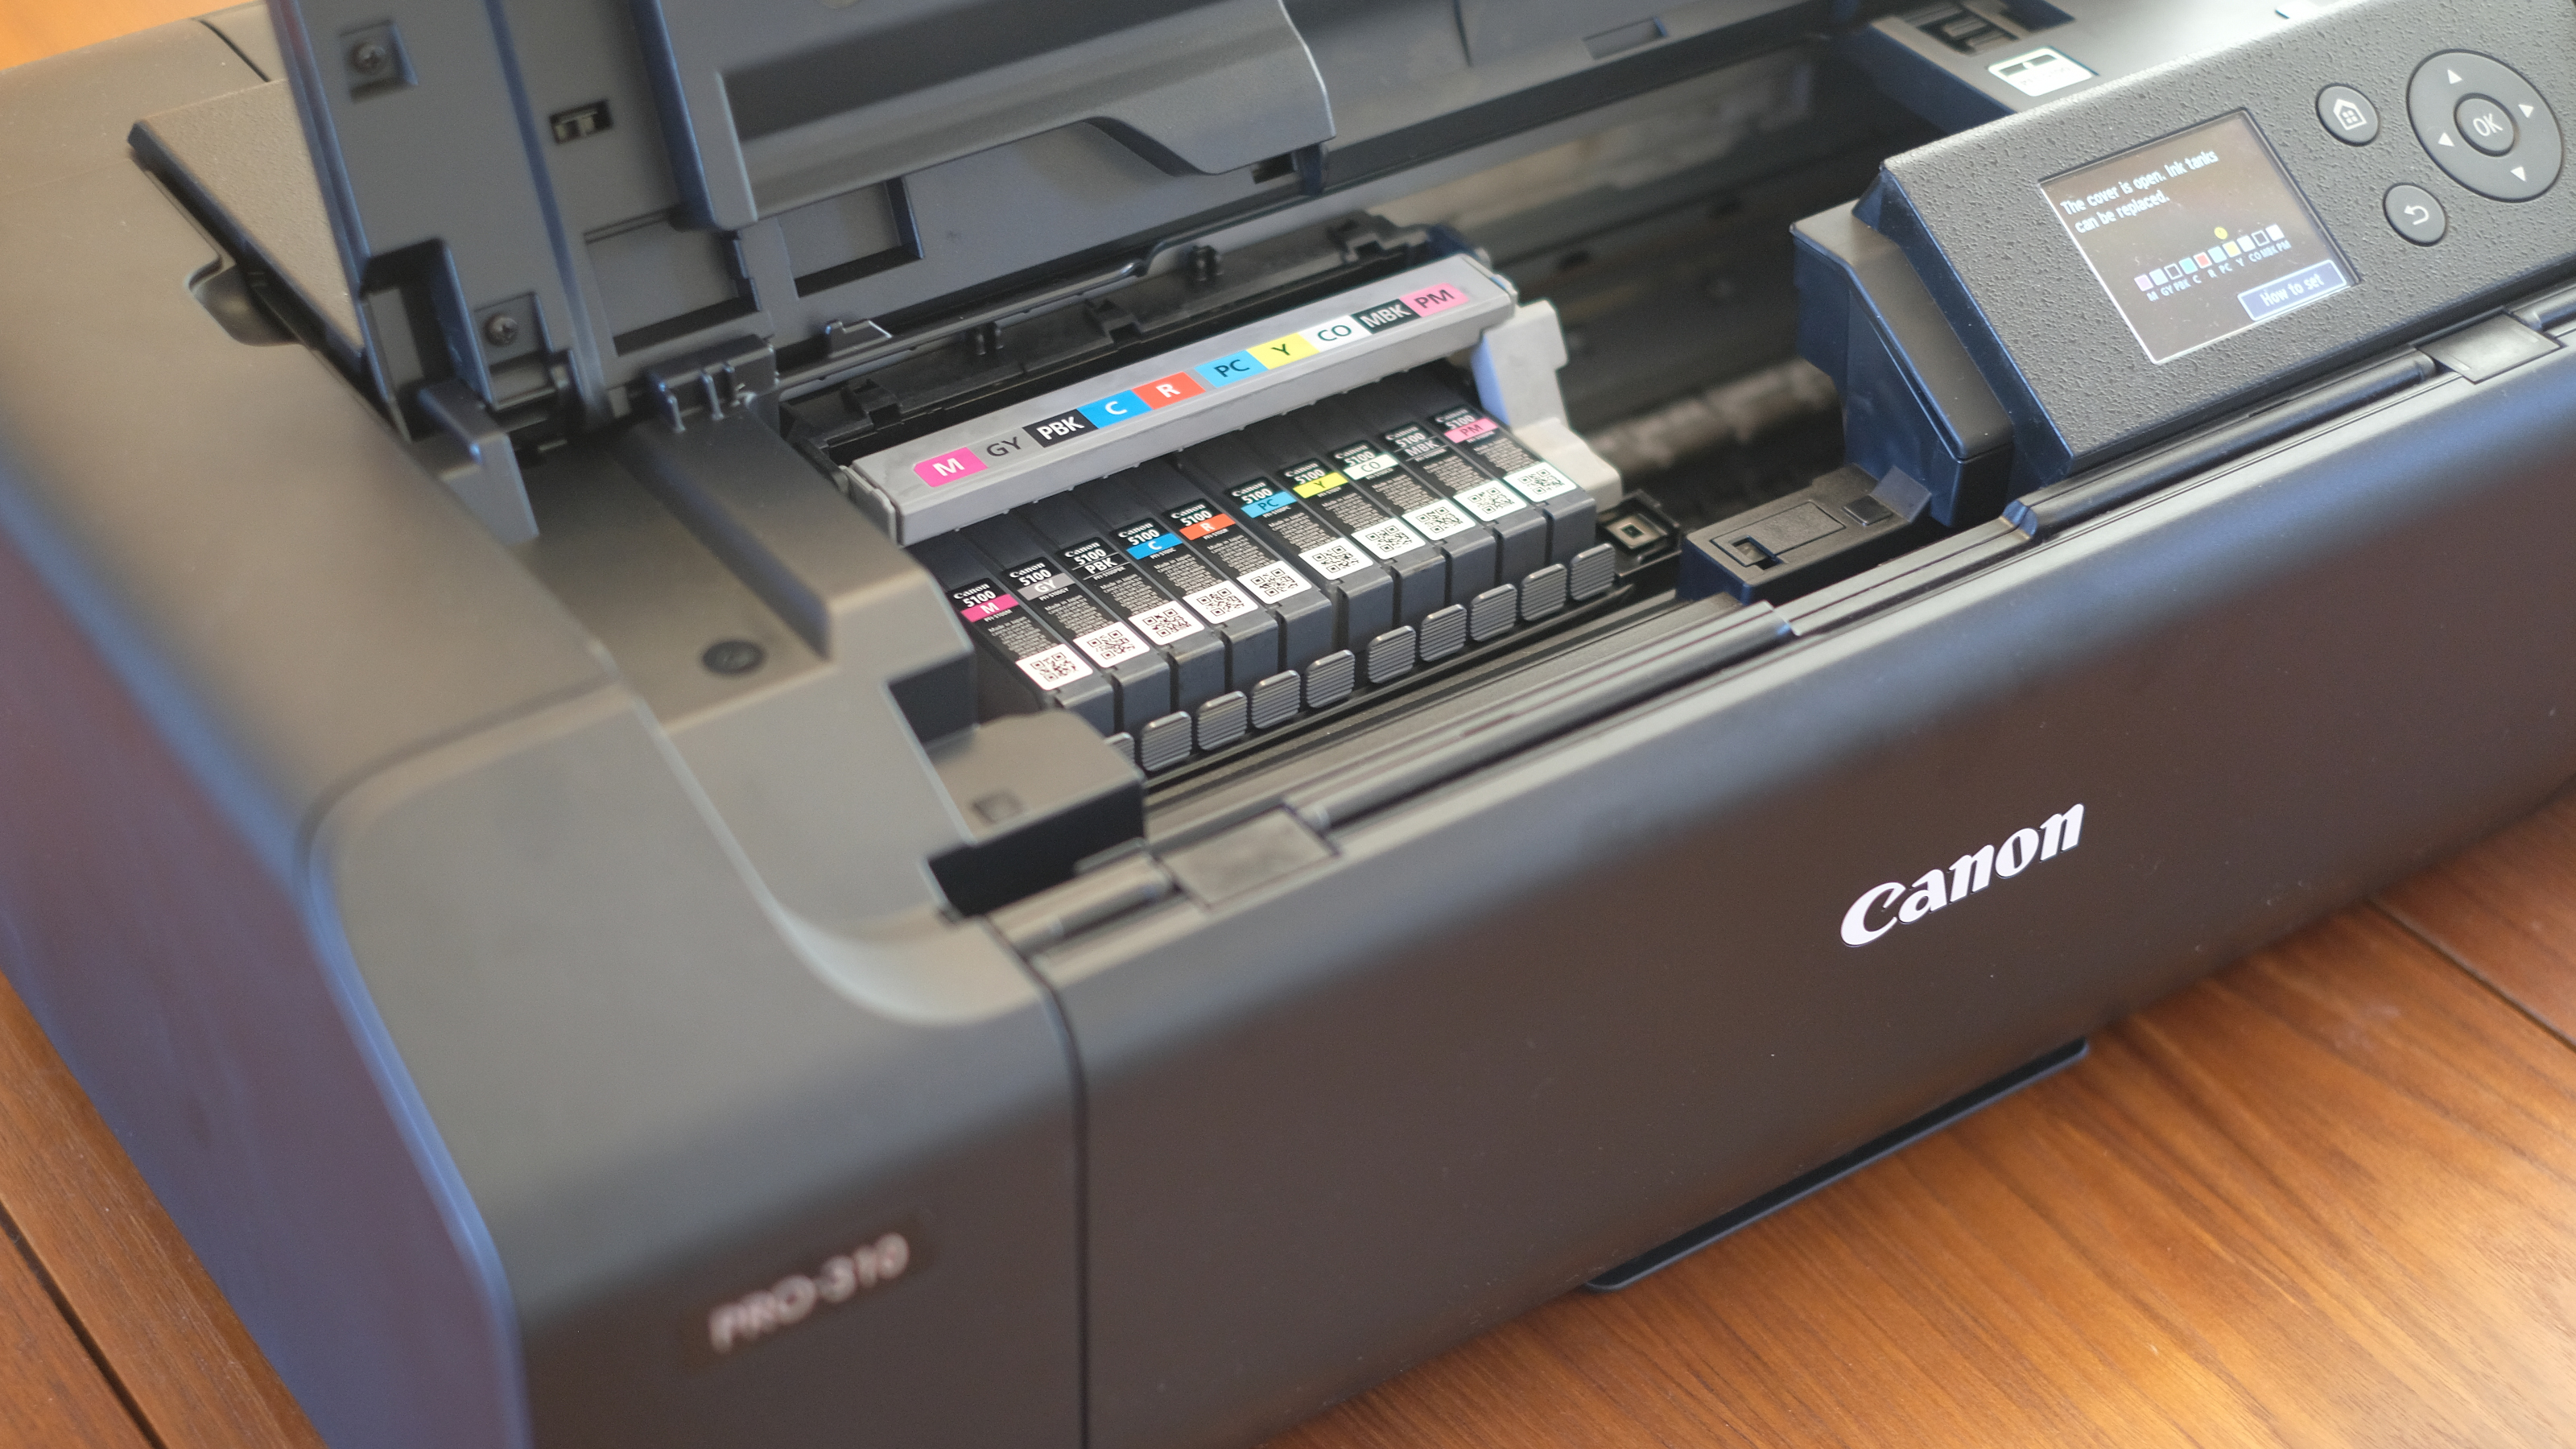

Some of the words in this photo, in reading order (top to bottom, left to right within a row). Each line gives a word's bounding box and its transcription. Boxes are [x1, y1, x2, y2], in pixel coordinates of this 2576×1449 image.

[2473, 114, 2503, 136] OK
[2060, 200, 2087, 215] The
[2087, 187, 2120, 207] cover
[2118, 181, 2133, 194] is
[2133, 171, 2167, 190] open.
[2164, 162, 2188, 177] Ink
[2185, 151, 2219, 170] tanks
[2075, 217, 2099, 233] can
[2096, 211, 2116, 225] be
[2116, 189, 2170, 218] replaced.
[2146, 291, 2159, 301] M
[2161, 285, 2174, 296] GY
[2193, 275, 2202, 283] C
[2207, 269, 2217, 278] R
[2219, 263, 2232, 274] PC
[2235, 258, 2244, 267] Y
[2260, 289, 2289, 307] How
[2288, 283, 2303, 295] to
[2304, 274, 2324, 290] set
[933, 457, 965, 477] M
[986, 436, 1022, 457] GY
[1037, 416, 1084, 440] PBK
[1105, 401, 1127, 415] C
[1155, 381, 1182, 399] R
[1213, 360, 1249, 378] PC
[1271, 343, 1290, 356] Y
[1318, 325, 1352, 341] CO
[1360, 304, 1411, 328] MBK
[1414, 289, 1455, 309] PM
[1436, 409, 1468, 423] Canon
[1445, 415, 1476, 430] 5100
[1385, 427, 1418, 440] Canon
[1460, 425, 1484, 436] PM
[1395, 432, 1426, 448] 5100
[1404, 440, 1439, 456] MBK
[1335, 445, 1368, 460] Canon
[1344, 452, 1375, 466] 5100
[1285, 463, 1319, 477] Canon
[1361, 461, 1381, 472] CO
[1294, 469, 1326, 485] 5100
[1314, 481, 1325, 489] Y
[1232, 482, 1265, 497] Canon
[1241, 489, 1273, 504] 5100
[1171, 504, 1206, 518] Canon
[1258, 499, 1279, 510] PC
[1180, 511, 1212, 526] 5100
[1118, 522, 1154, 538] Canon
[1199, 523, 1215, 531] R
[1128, 530, 1159, 546] 5100
[1148, 541, 1162, 550] C
[1064, 541, 1100, 558] Canon
[1074, 549, 1107, 565] 5100
[1009, 563, 1046, 579] Canon
[1085, 557, 1117, 574] PBK
[1019, 570, 1051, 586] 5100
[1034, 580, 1056, 592] GY
[953, 583, 990, 600] Canon
[963, 591, 996, 607] 5100
[980, 602, 999, 614] M
[1840, 803, 2084, 947] Canon
[708, 1232, 910, 1354] PRO-310
